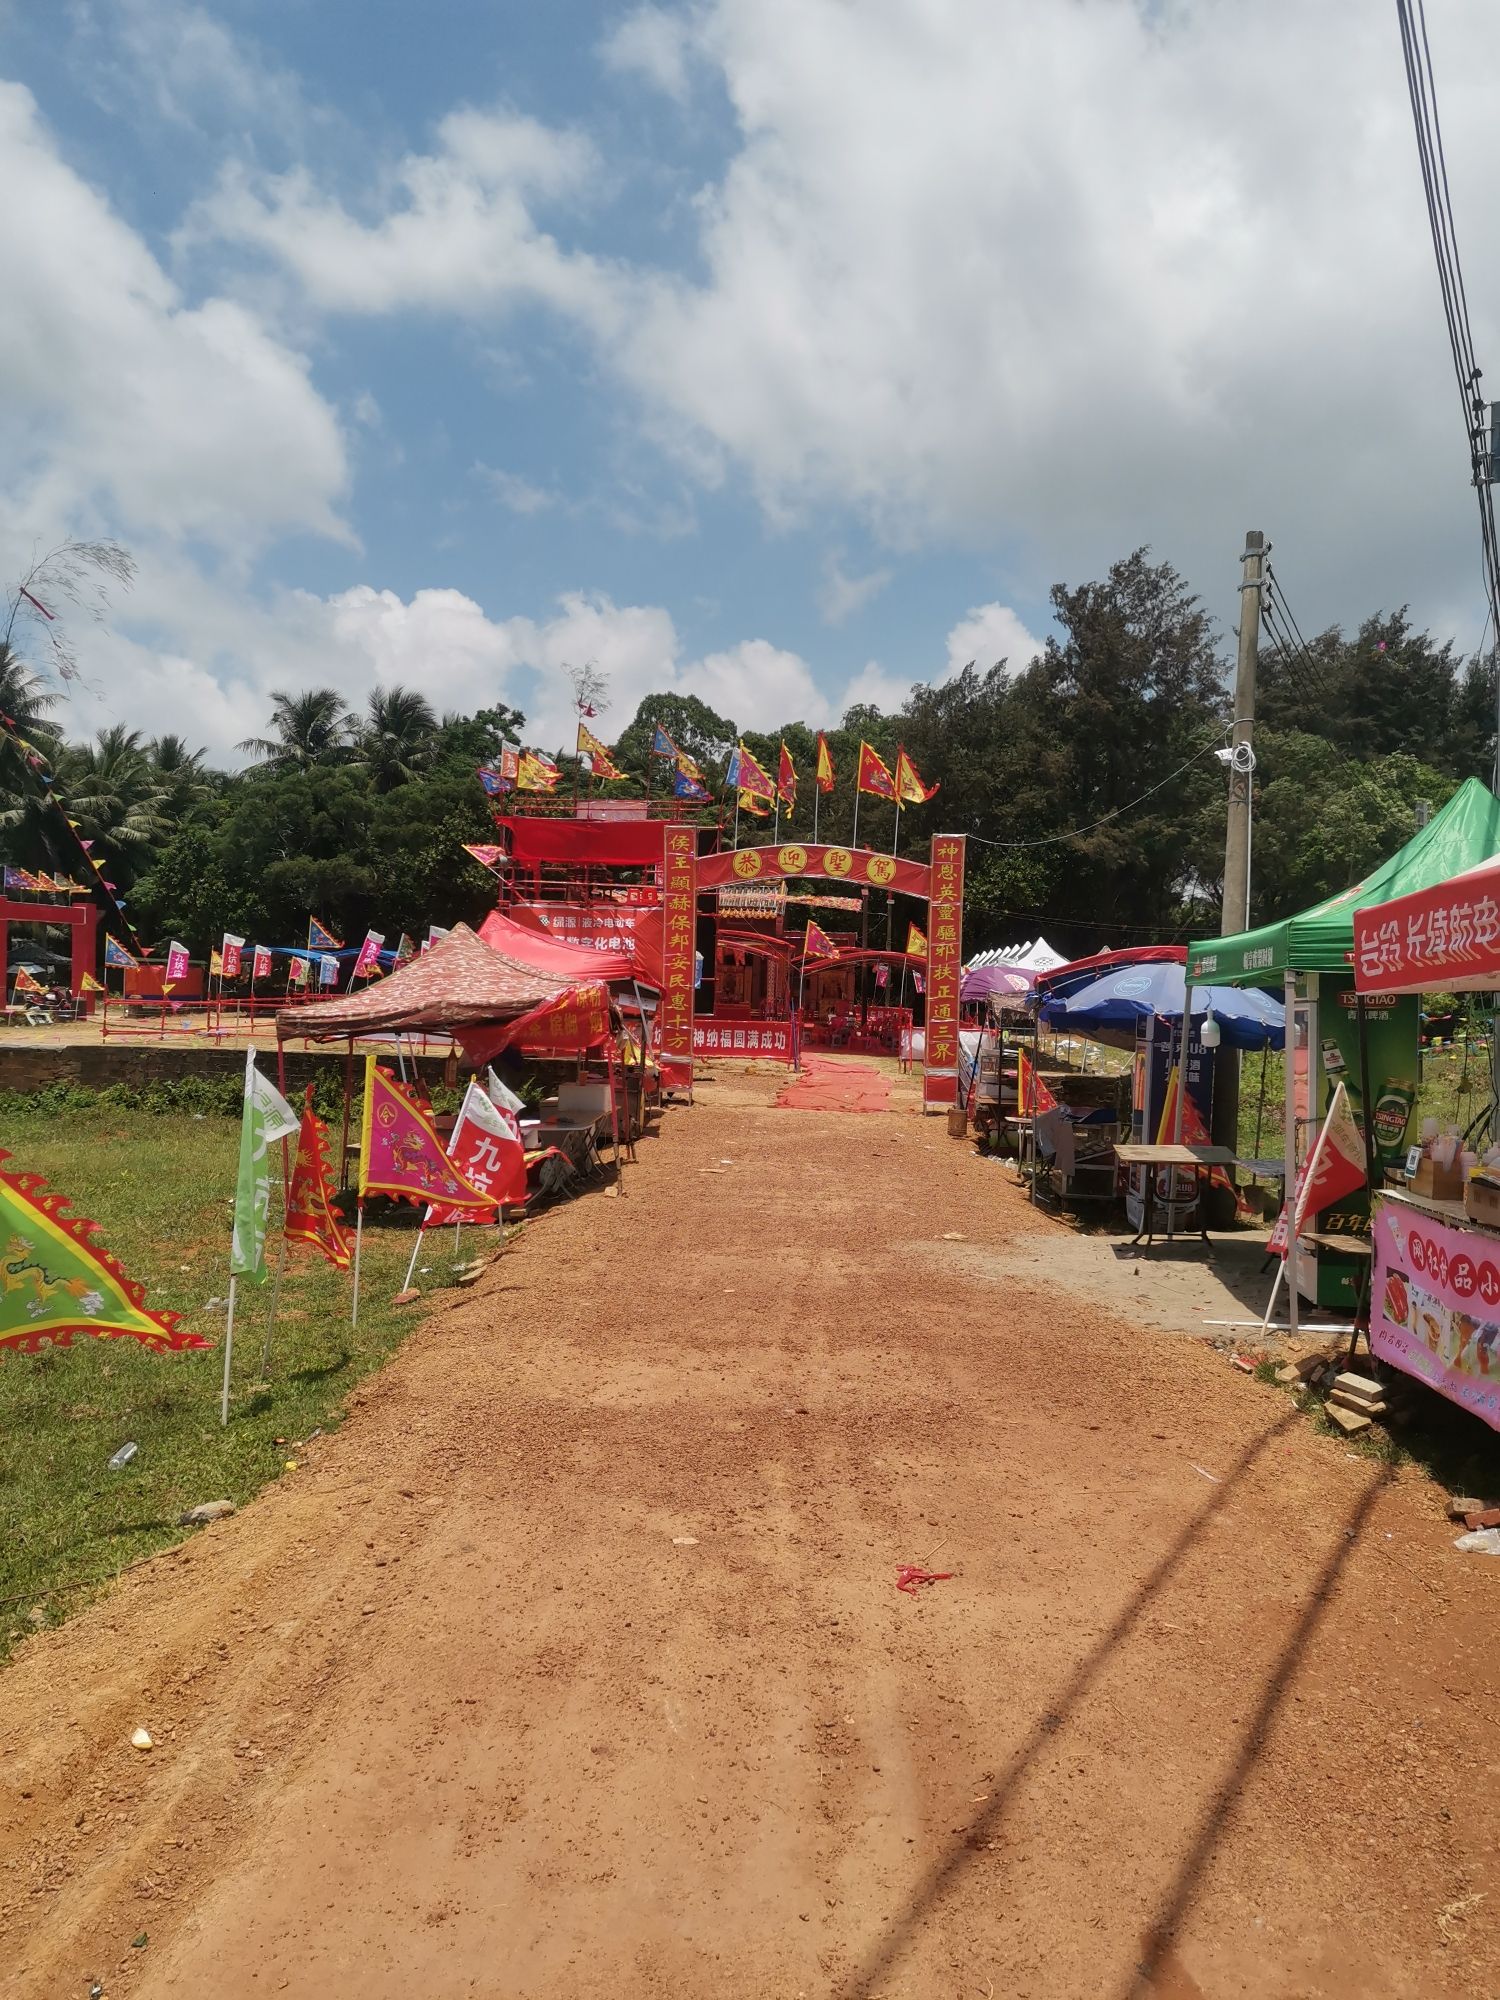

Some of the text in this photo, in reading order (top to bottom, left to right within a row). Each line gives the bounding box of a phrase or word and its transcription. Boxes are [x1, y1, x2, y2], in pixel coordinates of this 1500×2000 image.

[737, 849, 891, 881] 恭迎聖駕
[931, 842, 959, 1062] 神恩英靈驅邪扶正通三界
[1347, 1010, 1389, 1021] 青啤酒
[1375, 1113, 1406, 1125] TSINGTAO
